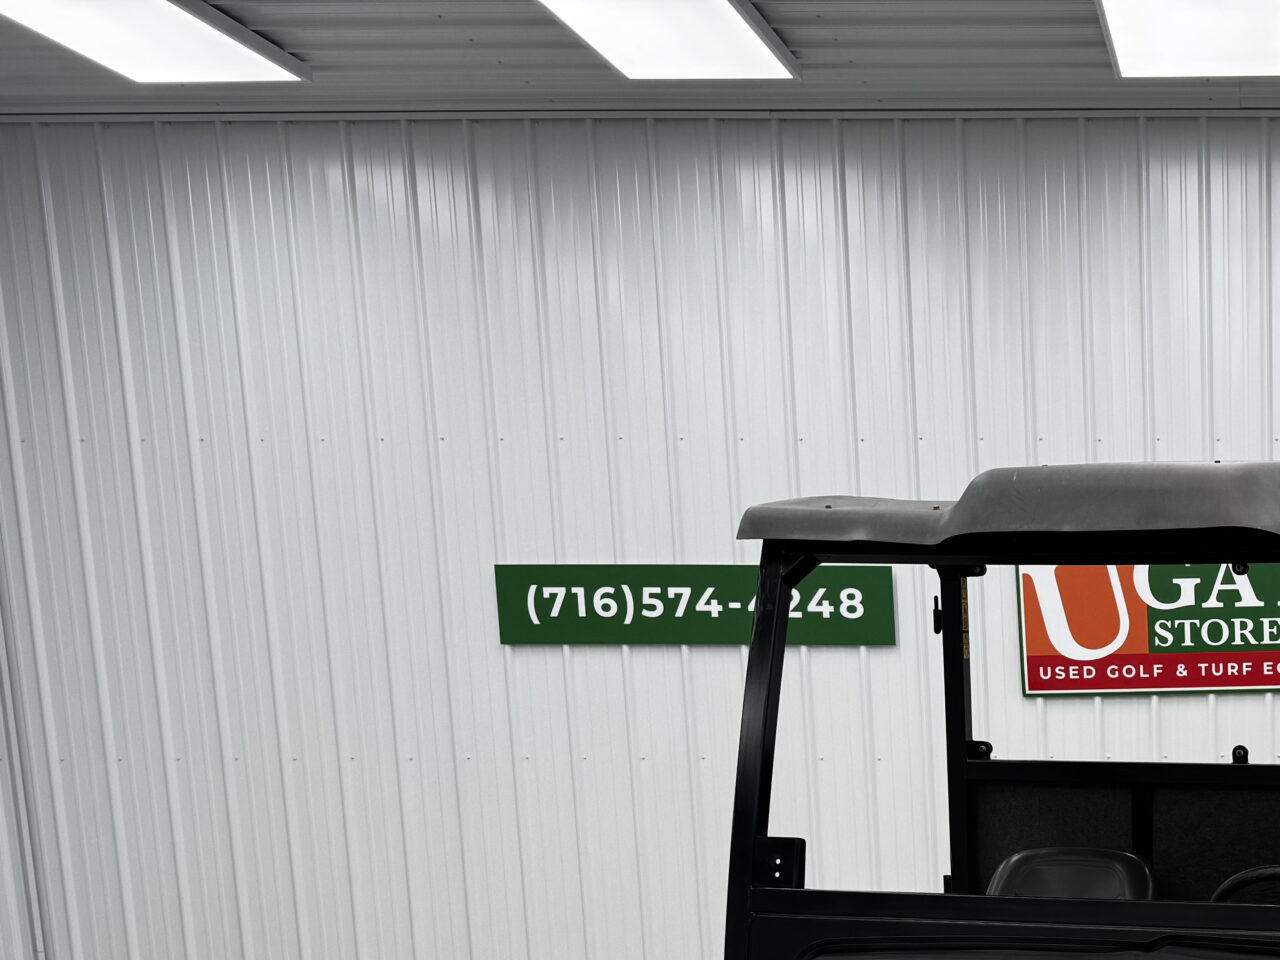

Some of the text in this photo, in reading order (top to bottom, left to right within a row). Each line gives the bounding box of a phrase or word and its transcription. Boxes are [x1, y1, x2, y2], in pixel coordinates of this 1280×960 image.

[527, 584, 865, 625] (716)574-248
[1039, 665, 1096, 680] USED
[1106, 664, 1164, 679] GOLF
[1175, 663, 1188, 677] &
[1198, 662, 1253, 677] TURF
